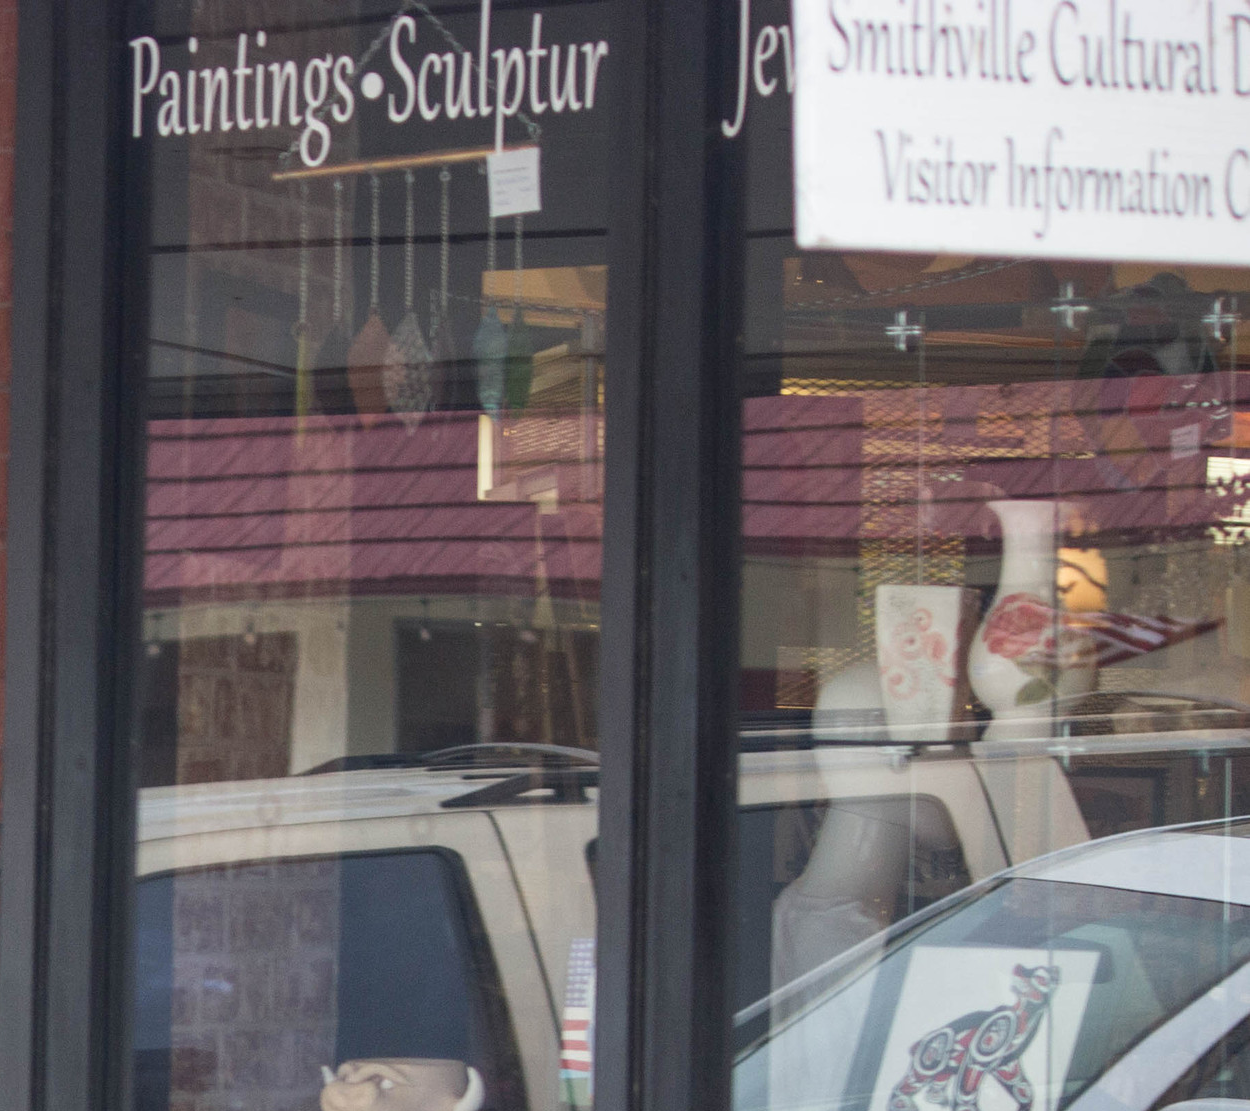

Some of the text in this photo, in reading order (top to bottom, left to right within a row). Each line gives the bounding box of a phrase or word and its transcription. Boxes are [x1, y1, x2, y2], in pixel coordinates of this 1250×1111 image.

[827, 0, 1037, 83] Smithville
[1051, 0, 1220, 95] Cultural
[875, 128, 997, 208] Visitor
[1005, 126, 1216, 240] Information
